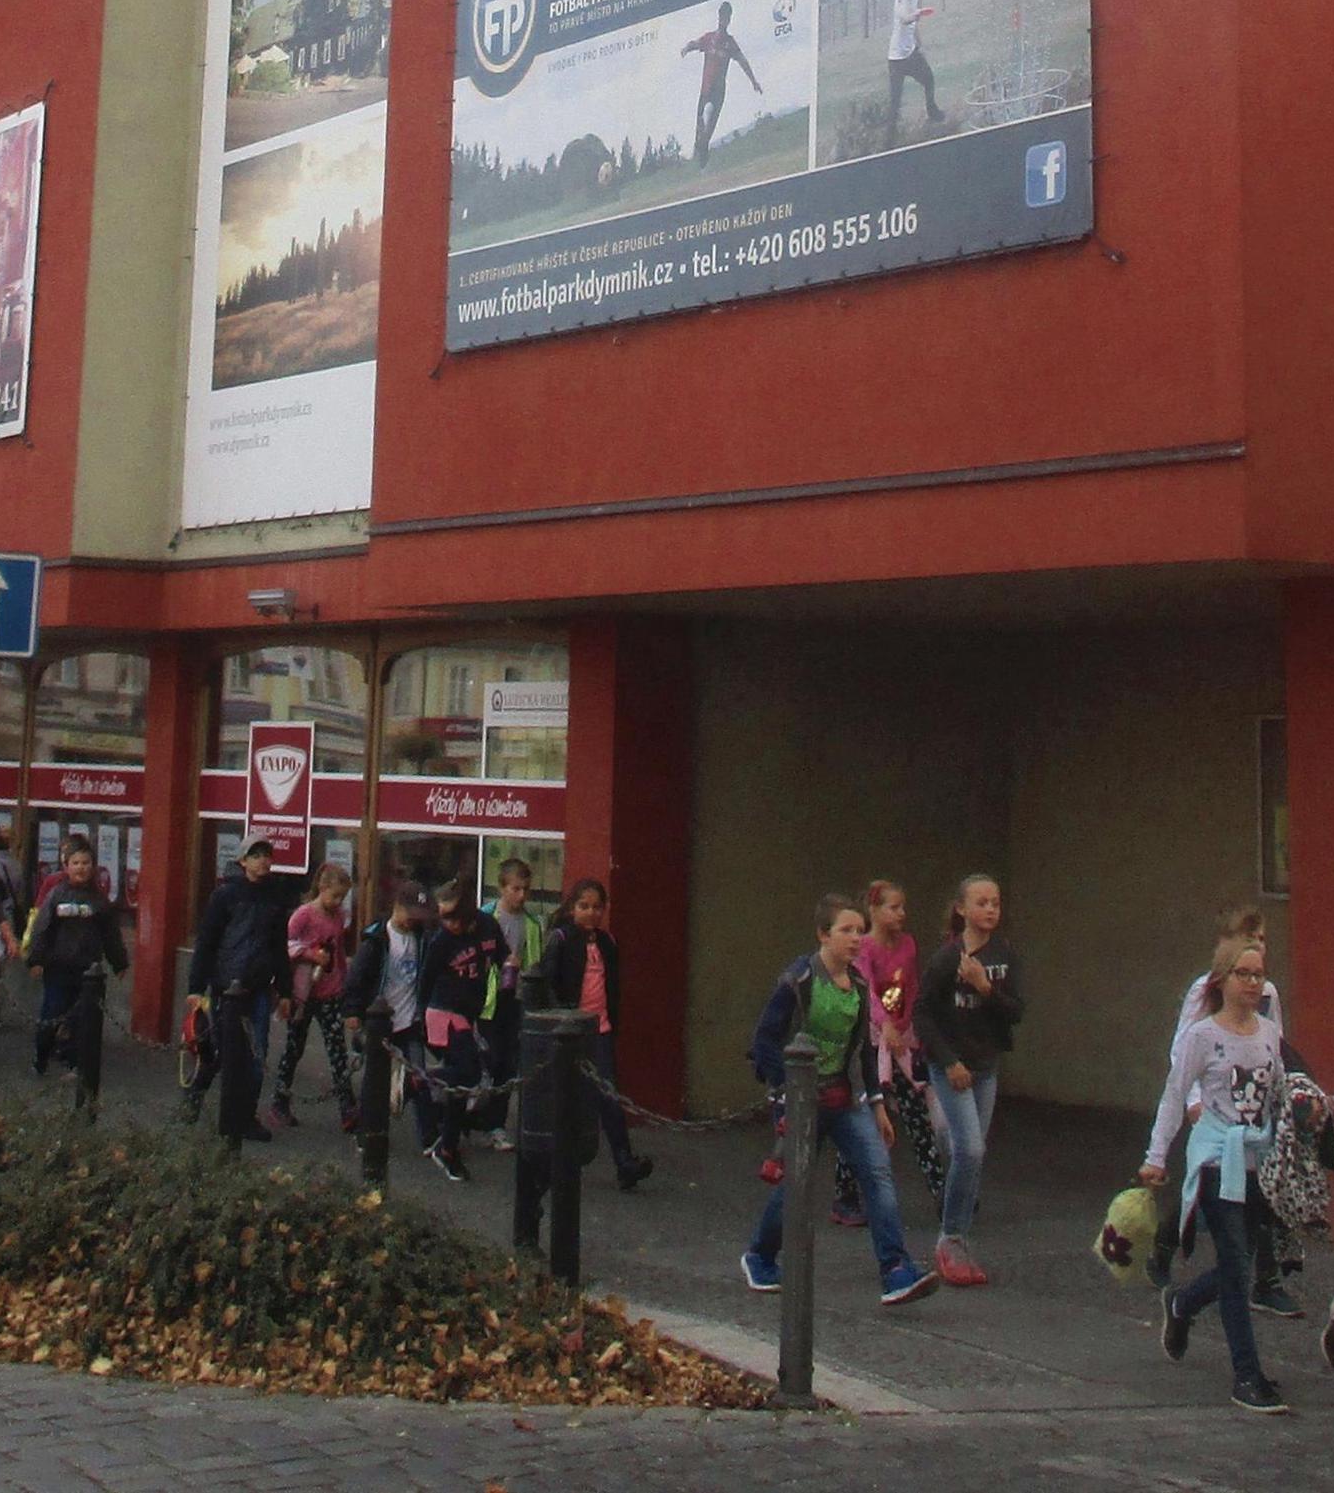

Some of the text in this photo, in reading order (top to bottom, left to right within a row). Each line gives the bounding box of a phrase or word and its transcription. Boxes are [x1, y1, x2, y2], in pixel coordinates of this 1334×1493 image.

[611, 231, 665, 256] REPUBLICE
[676, 216, 730, 242] OTEVŘENO
[770, 203, 794, 221] DEN
[458, 203, 917, 324] www.fotbalparkdymnik.cz tel.: +420 608 555 106
[426, 787, 458, 823] Každý
[459, 791, 476, 817] den
